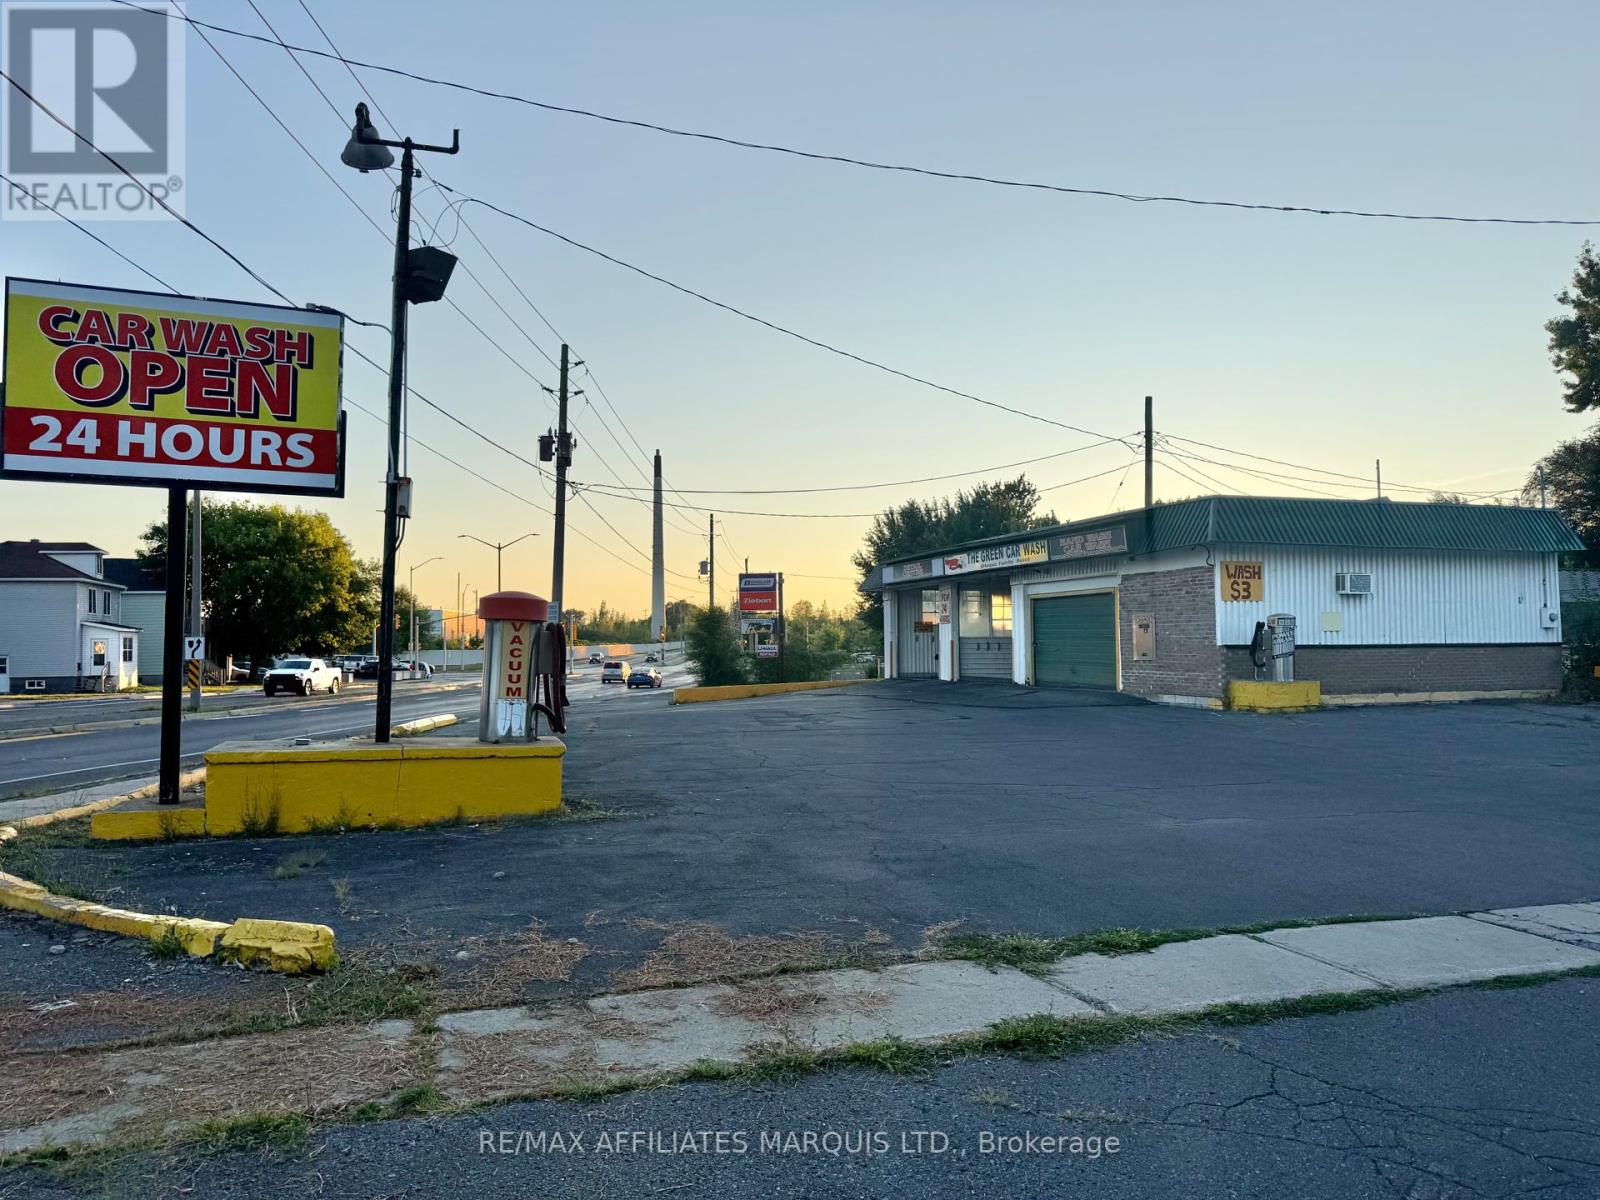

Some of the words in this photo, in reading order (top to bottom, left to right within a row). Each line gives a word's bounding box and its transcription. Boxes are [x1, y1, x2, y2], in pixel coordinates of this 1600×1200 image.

[38, 305, 154, 351] CAR
[159, 316, 314, 369] WASH
[54, 343, 298, 423] OPEN
[29, 415, 101, 454] 24
[117, 420, 315, 468] HOURS
[966, 551, 979, 565] THE
[980, 546, 1005, 562] GREEN
[1006, 544, 1021, 559] CAR
[1022, 542, 1046, 556] WASH
[1224, 564, 1262, 581] WASH
[1230, 580, 1252, 600] $3
[506, 622, 523, 697] VACUUM
